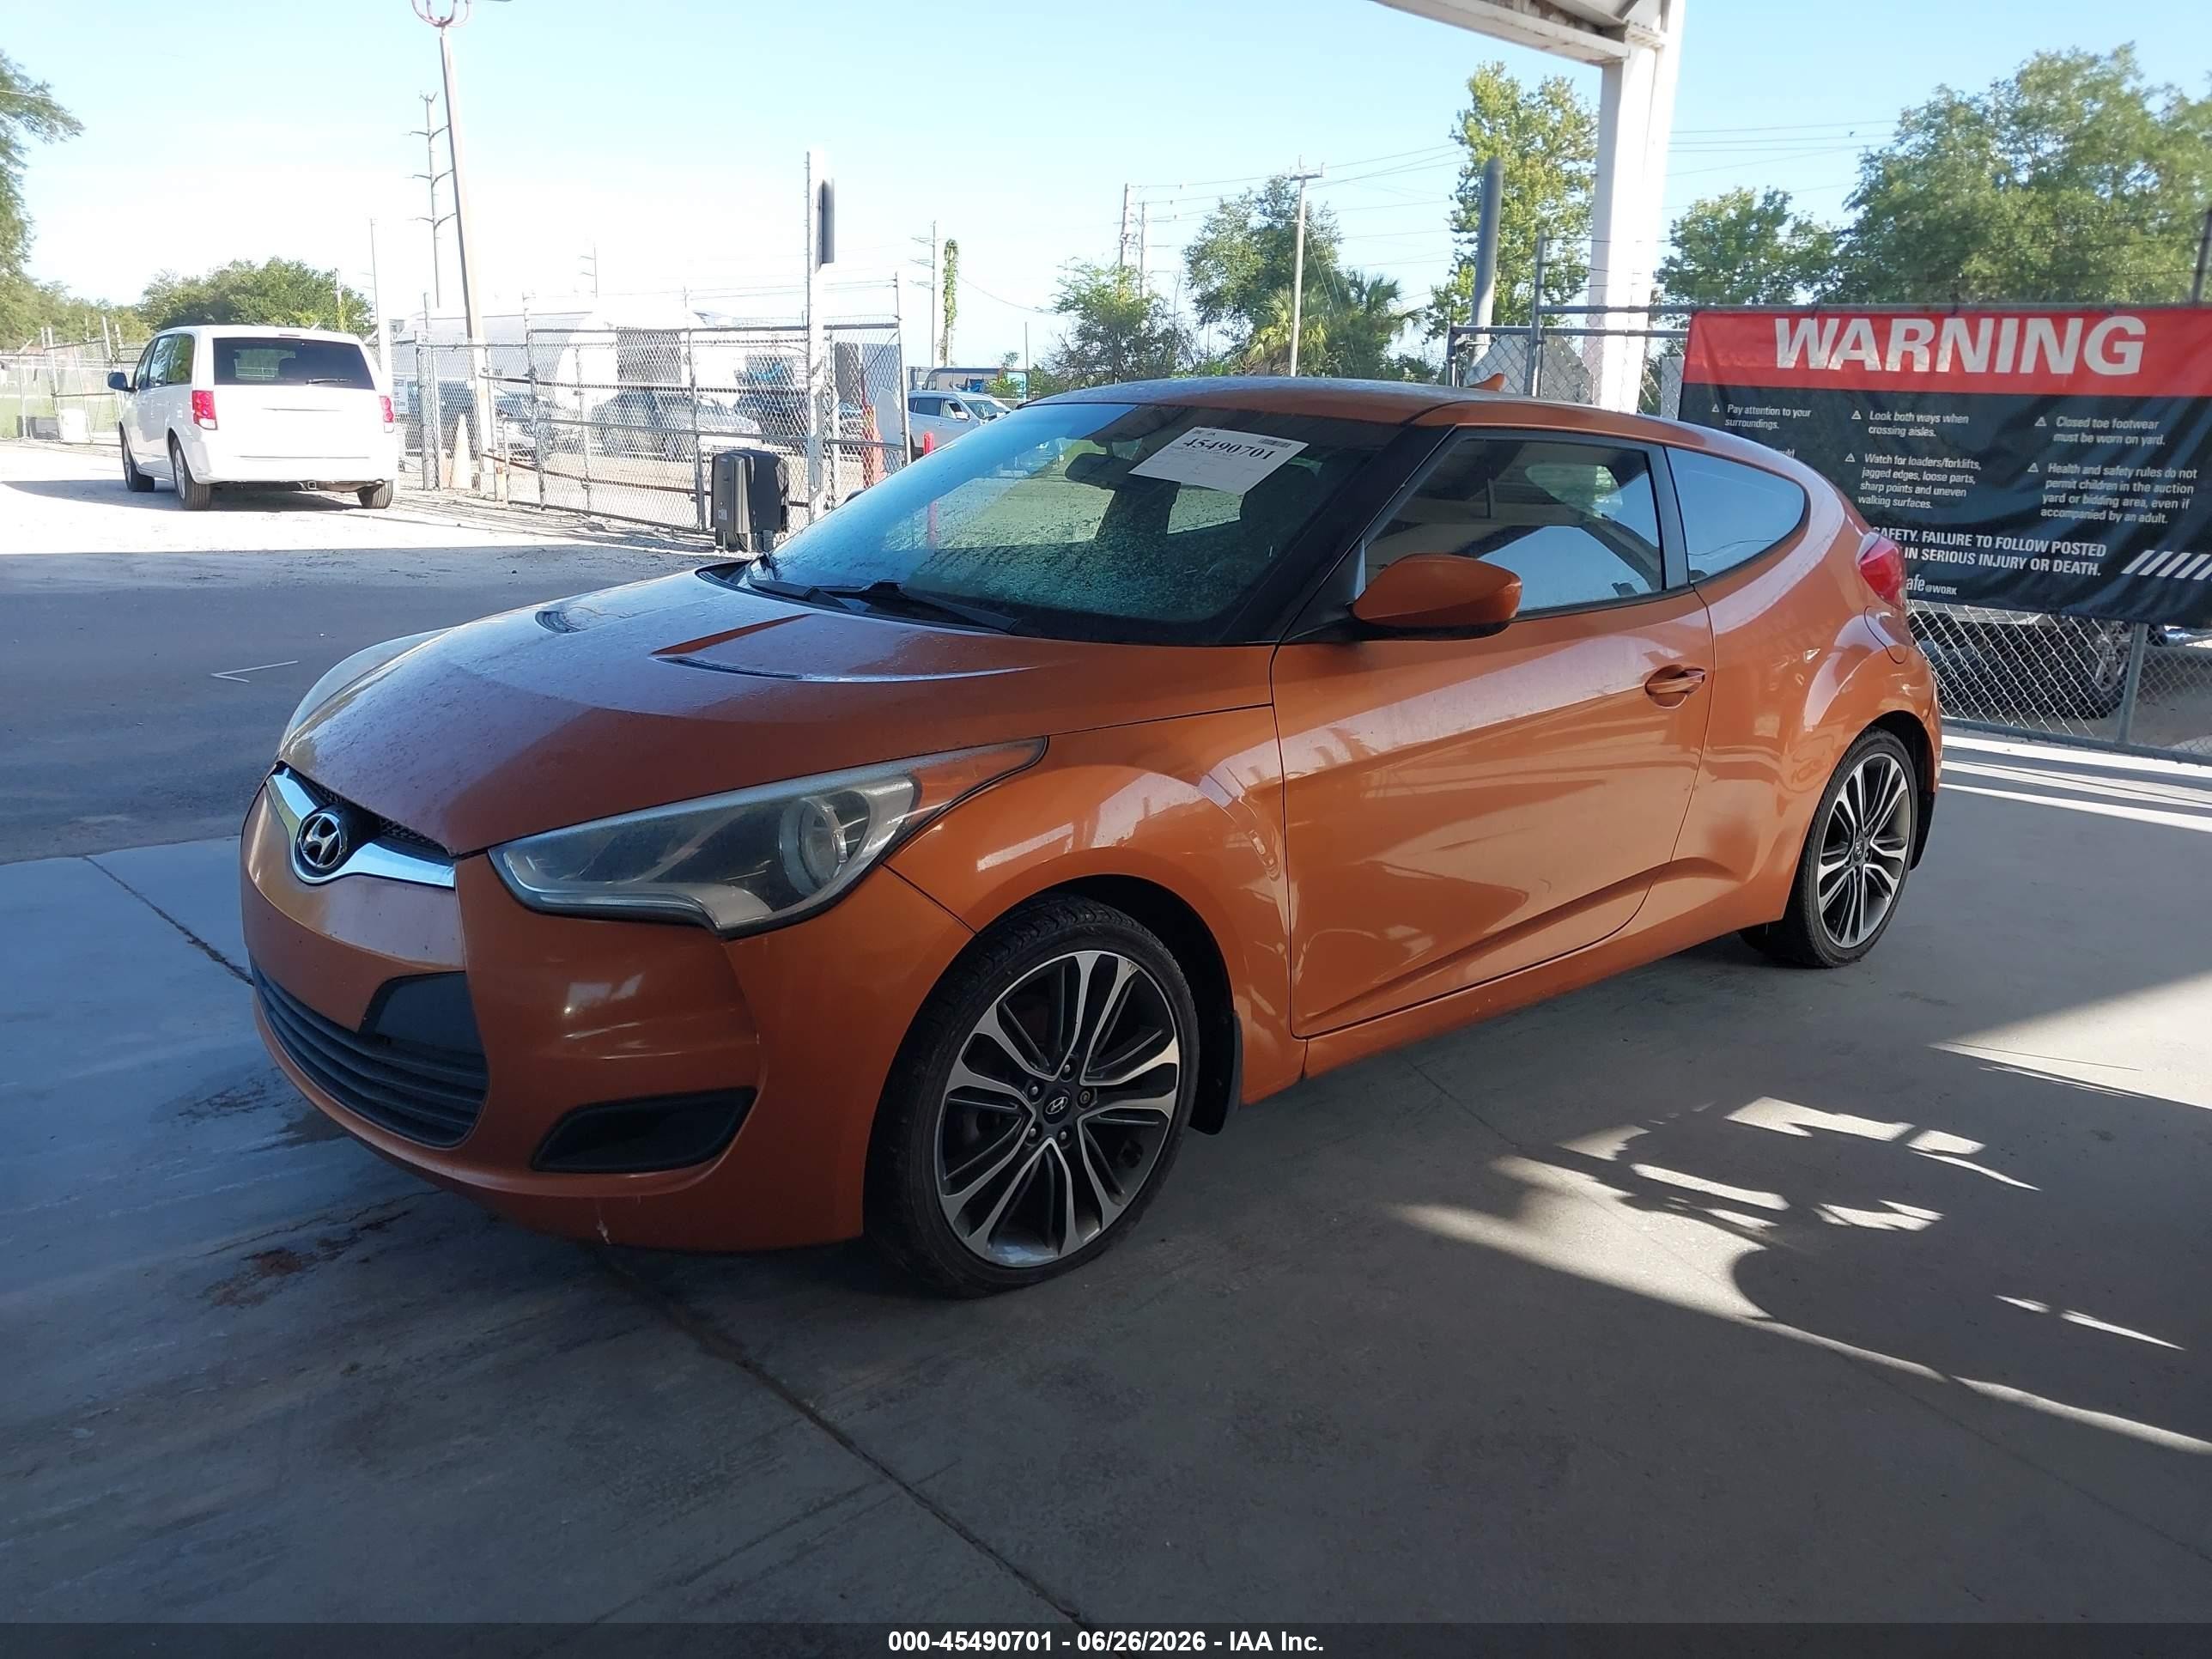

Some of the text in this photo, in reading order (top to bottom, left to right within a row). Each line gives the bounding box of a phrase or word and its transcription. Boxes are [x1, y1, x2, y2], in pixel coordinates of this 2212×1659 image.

[1775, 315, 2146, 375] WARNING
[1728, 404, 1811, 418] Pay attention to your
[1869, 410, 1969, 424] Look both ways when
[1725, 418, 1779, 430] surroundings.
[2056, 416, 2159, 429] Closed toe footwear
[1869, 426, 1936, 437] crossing aisles.
[2053, 432, 2166, 447] must be worn on yard.
[1183, 438, 1275, 460] 45490701
[1864, 453, 1982, 471] Watch for loaders/forklifts,
[1862, 467, 1976, 484] jagged edges, loose parts,
[2048, 463, 2197, 479] Health and safety rules do not
[1860, 481, 1966, 496] sharp points and uneven
[2045, 478, 2194, 495] permit children in the auction
[1858, 495, 1933, 508] walking surfaces.
[2042, 493, 2191, 509] yard or bidding area, even if
[2040, 507, 2168, 524] accompanied by an adult.
[1922, 531, 1973, 546] FAILURE
[1976, 535, 1992, 548] TO
[1995, 537, 2049, 553] FOLLOW
[2051, 541, 2106, 556] POSTED
[1904, 546, 2101, 576] IN SERIOUS INJURY OR DEATH.
[1906, 574, 1958, 595] afe@WORK
